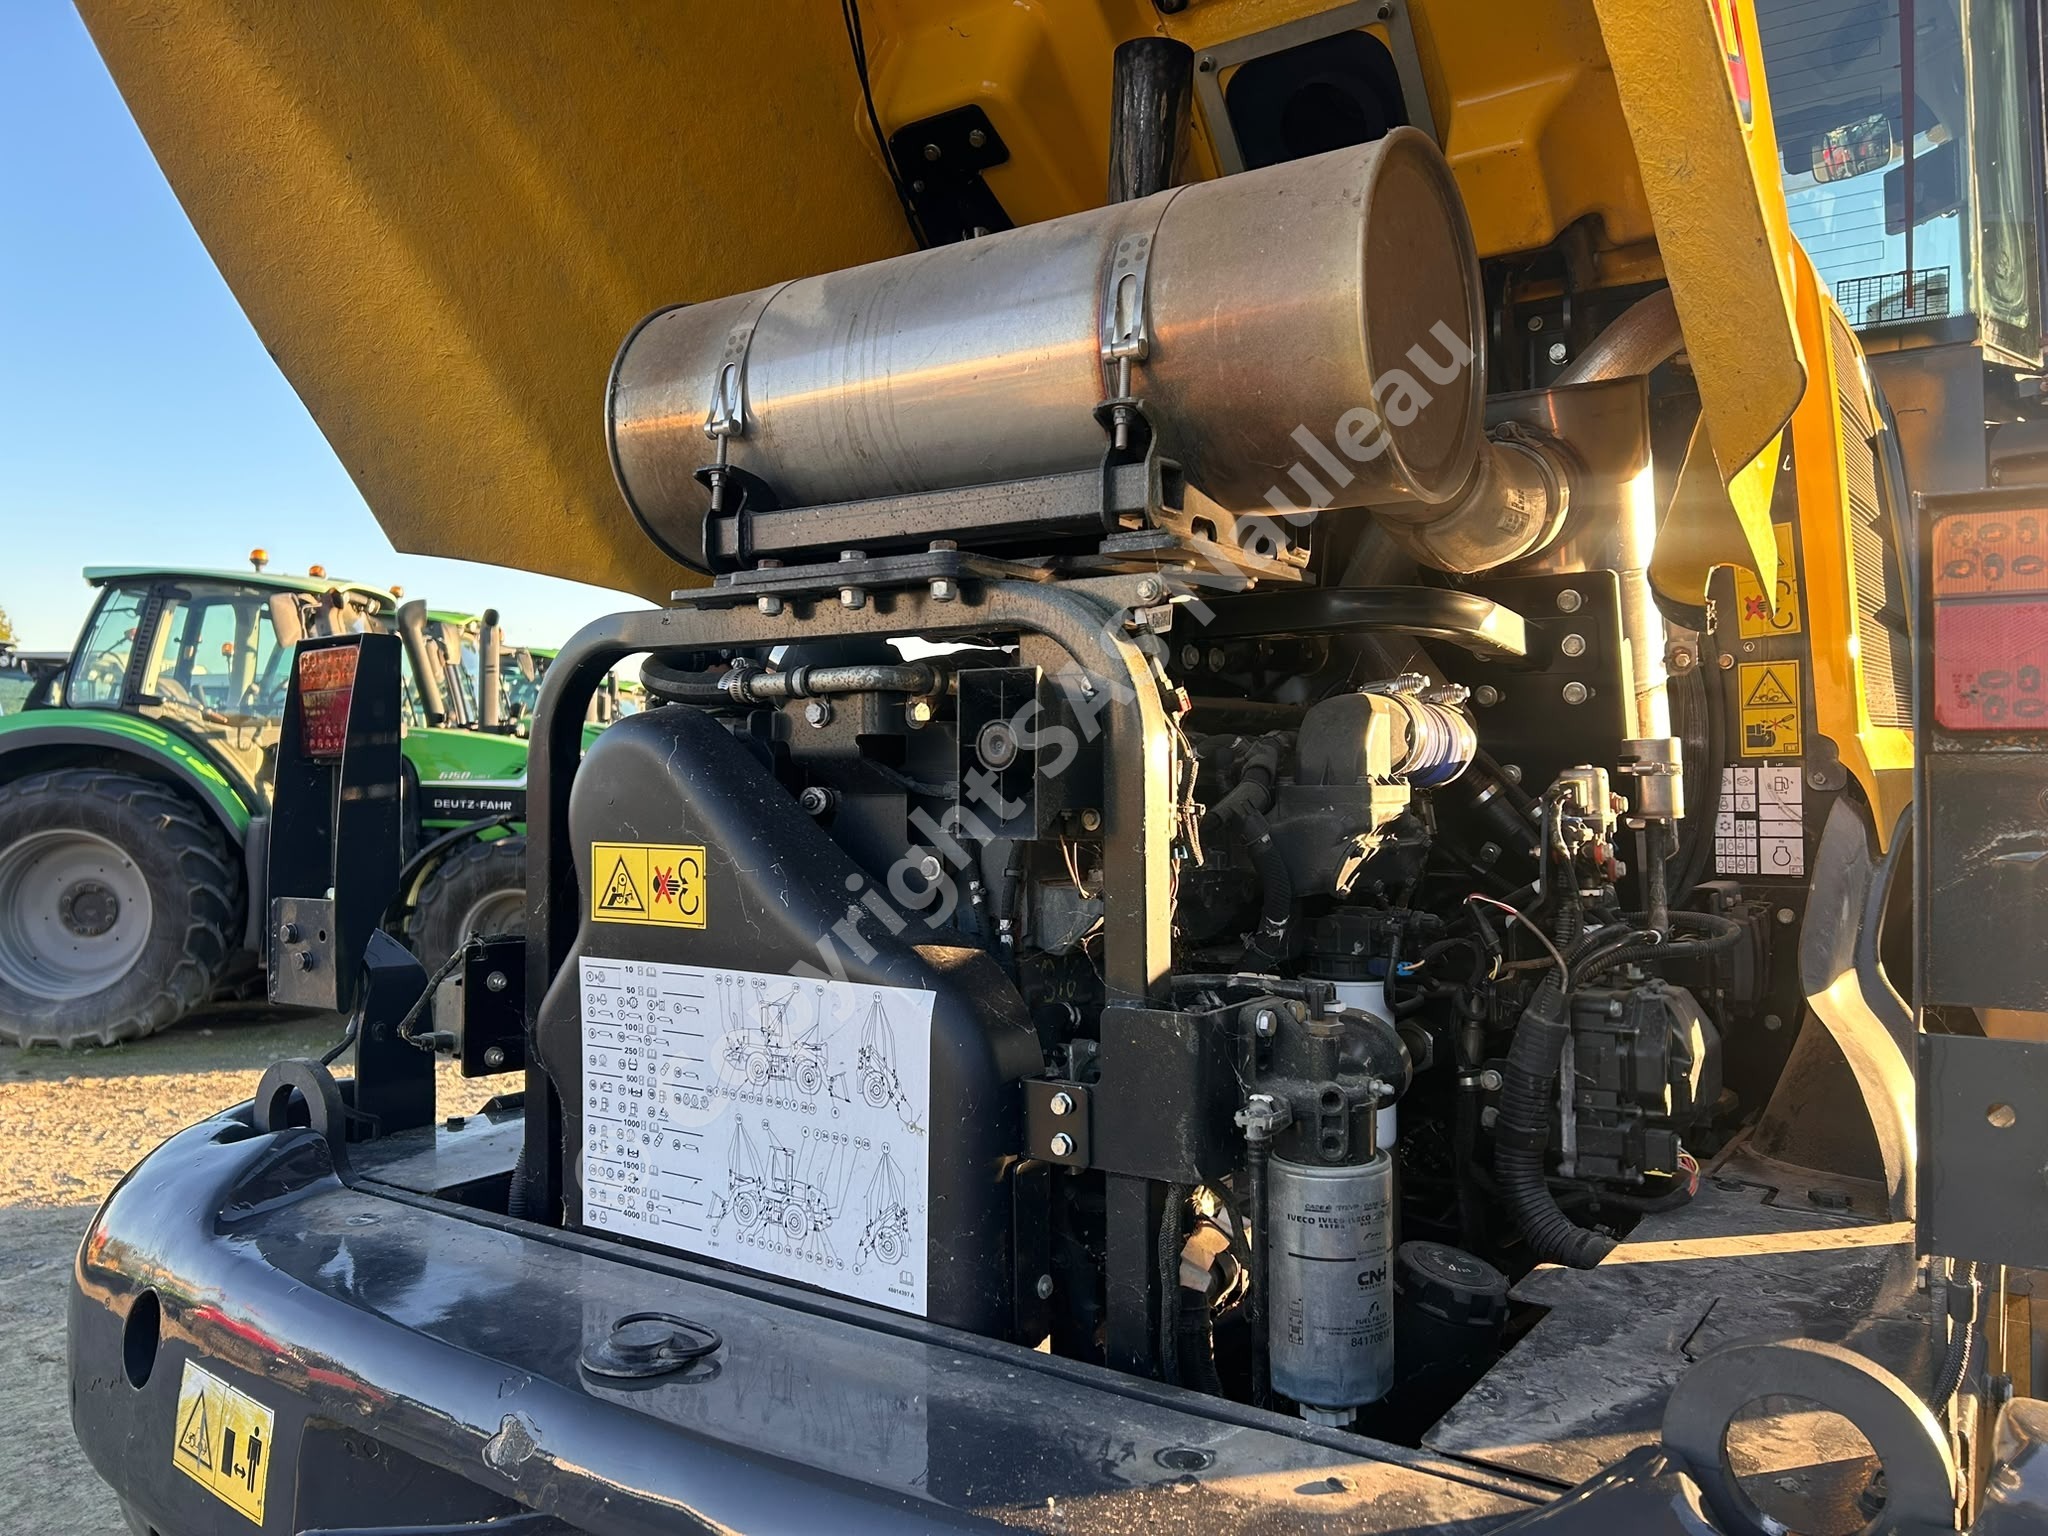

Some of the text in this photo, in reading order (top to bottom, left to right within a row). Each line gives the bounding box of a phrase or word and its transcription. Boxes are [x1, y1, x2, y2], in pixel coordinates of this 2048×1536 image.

[626, 986, 636, 994] 50
[624, 1023, 638, 1031] 100
[624, 1047, 638, 1056] 250
[626, 1074, 638, 1083] 500
[623, 1119, 640, 1128] 1000
[623, 1161, 640, 1170] 1500
[623, 1185, 640, 1195] 2000
[623, 1210, 640, 1220] 4000
[1287, 1213, 1315, 1224] IVECO
